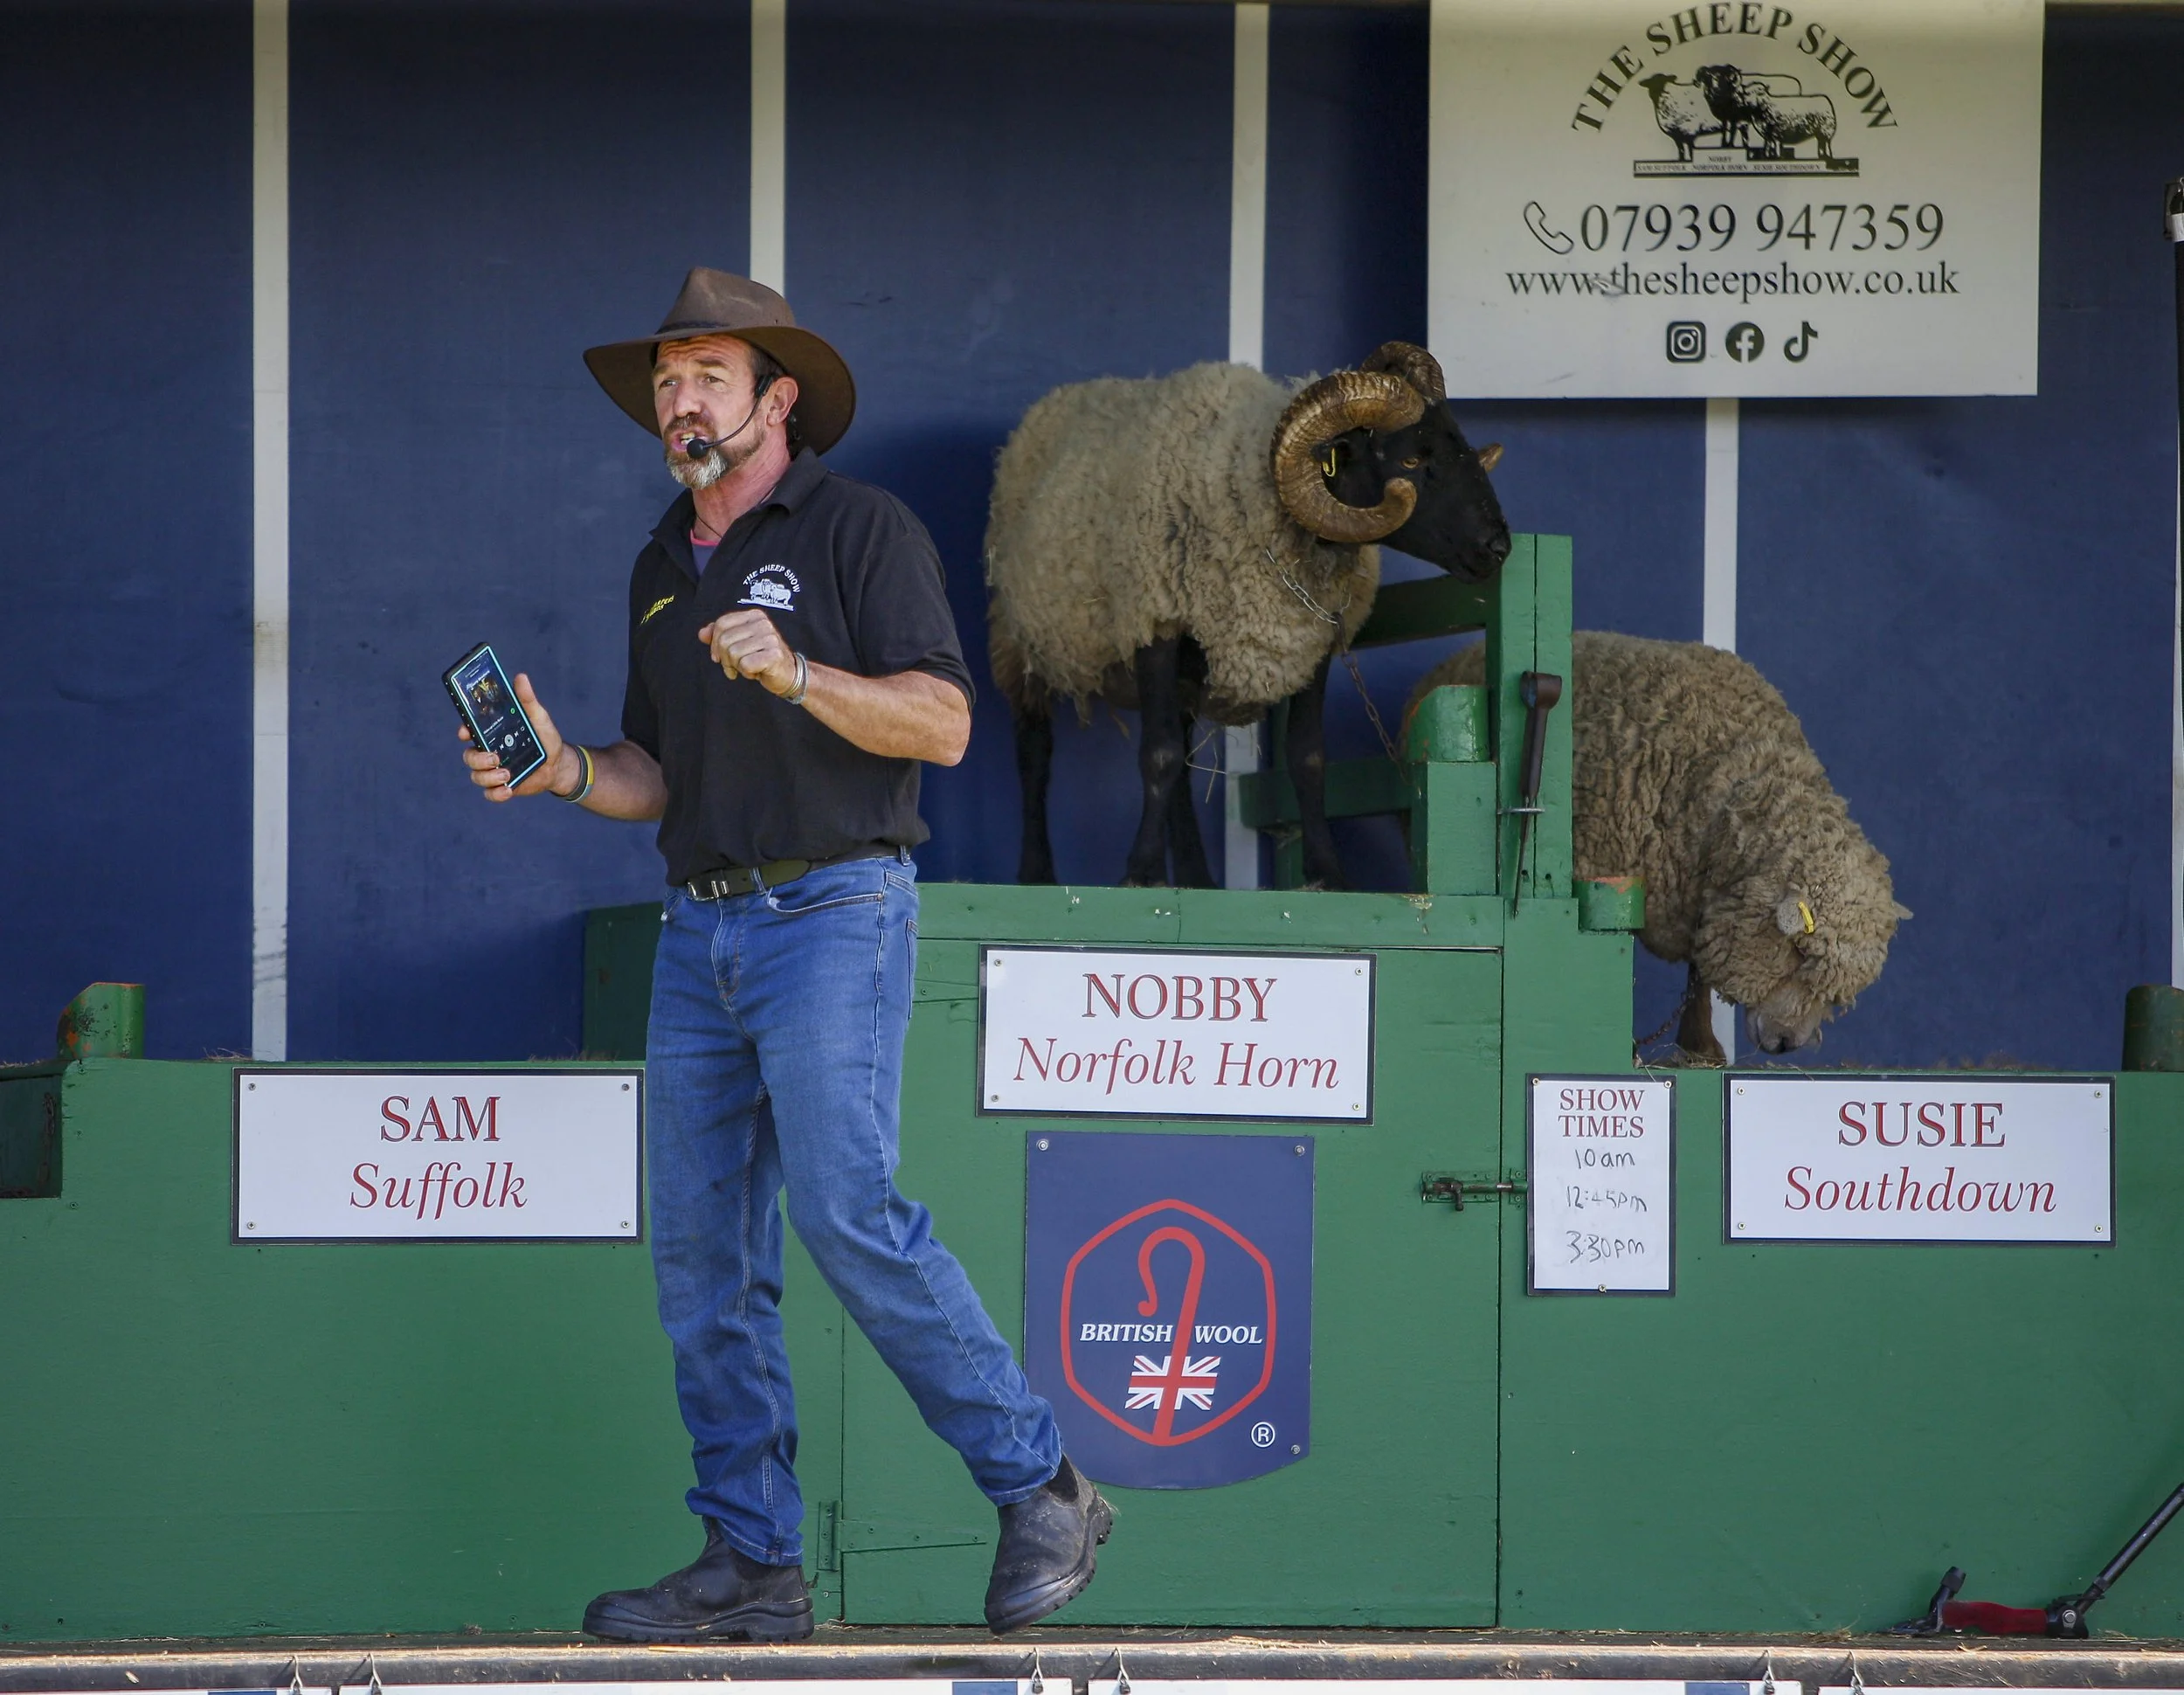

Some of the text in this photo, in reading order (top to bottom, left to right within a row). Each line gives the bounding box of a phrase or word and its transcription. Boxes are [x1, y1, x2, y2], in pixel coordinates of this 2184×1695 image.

[1572, 1, 1899, 134] THE SHEEP SHOW
[1579, 202, 1945, 253] 07939 947359
[743, 564, 801, 592] THE SHEEP SHOW
[1082, 972, 1278, 1022] NOBBY
[1013, 1037, 1340, 1096] Norfolk Horn
[380, 1095, 501, 1142] SAM
[1559, 1088, 1646, 1112] SHOW
[1558, 1115, 1645, 1138] TIMES
[1838, 1101, 2007, 1148] SUSIE
[349, 1161, 529, 1220] Suffolk
[1784, 1166, 2058, 1214] Southdown
[1079, 1323, 1263, 1345] BRITISH WOOL
